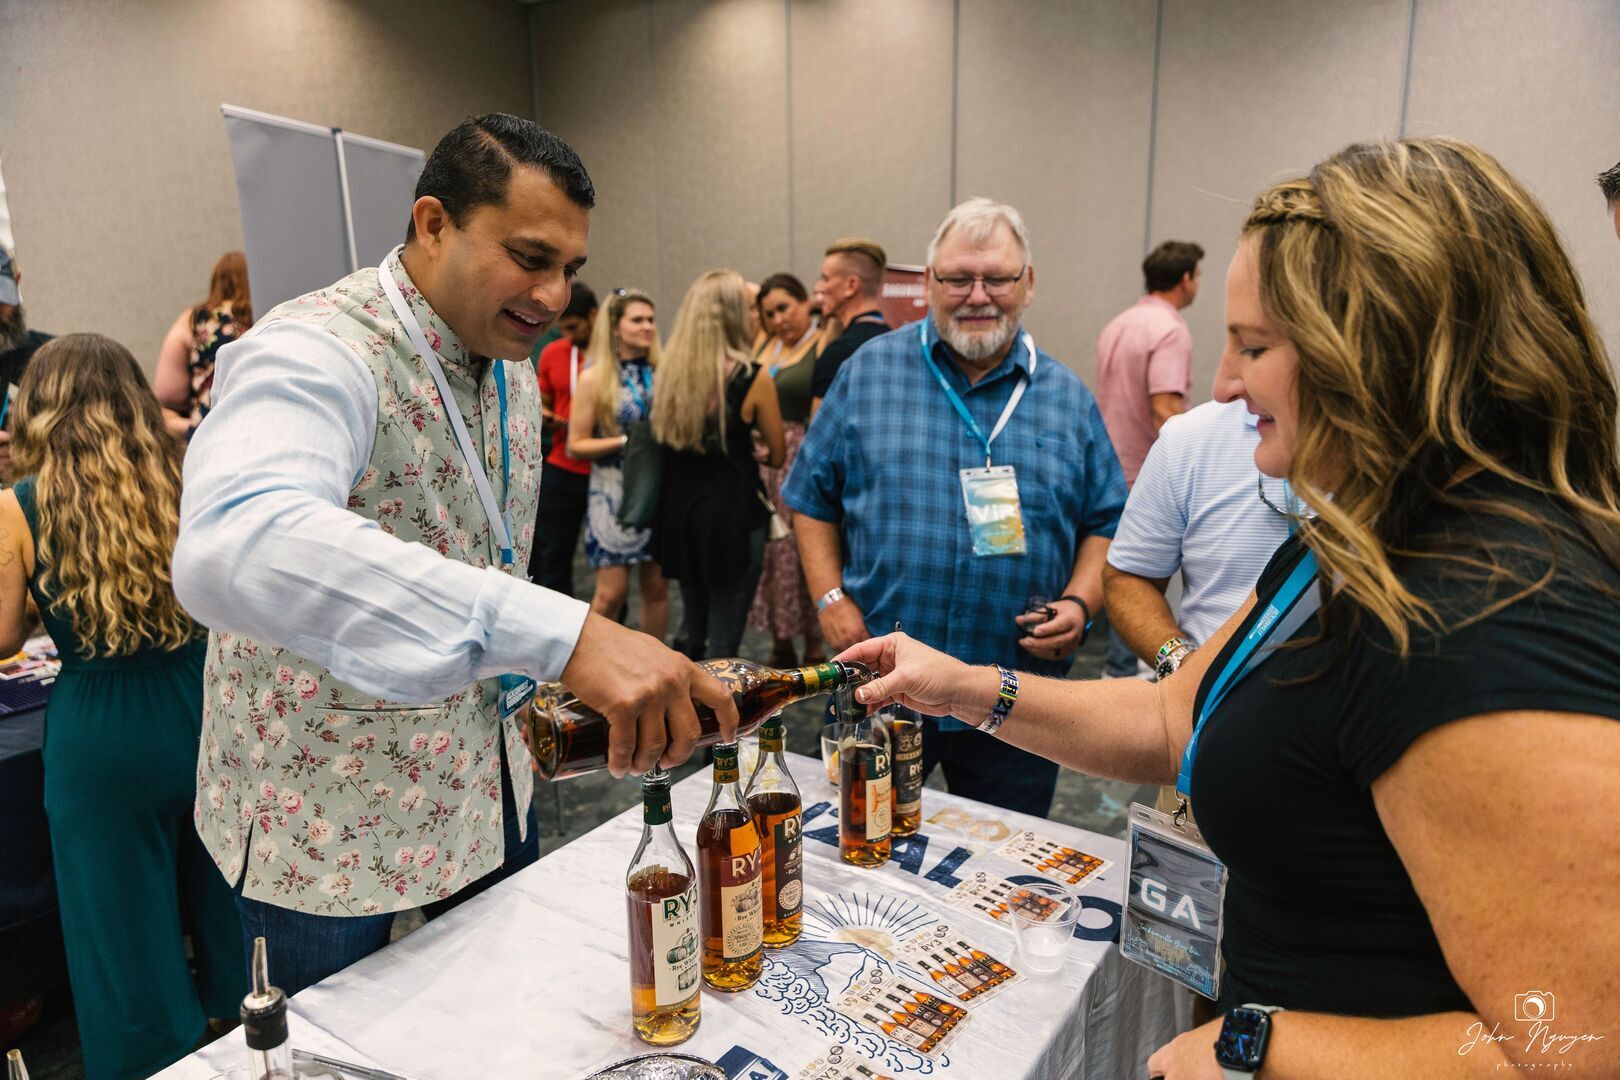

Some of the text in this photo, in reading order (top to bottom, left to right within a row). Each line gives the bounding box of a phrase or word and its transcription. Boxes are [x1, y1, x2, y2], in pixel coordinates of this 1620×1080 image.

[971, 504, 1016, 525] VIP
[1140, 878, 1201, 930] GA
[920, 940, 942, 952] RY3
[861, 985, 882, 1002] RY3
